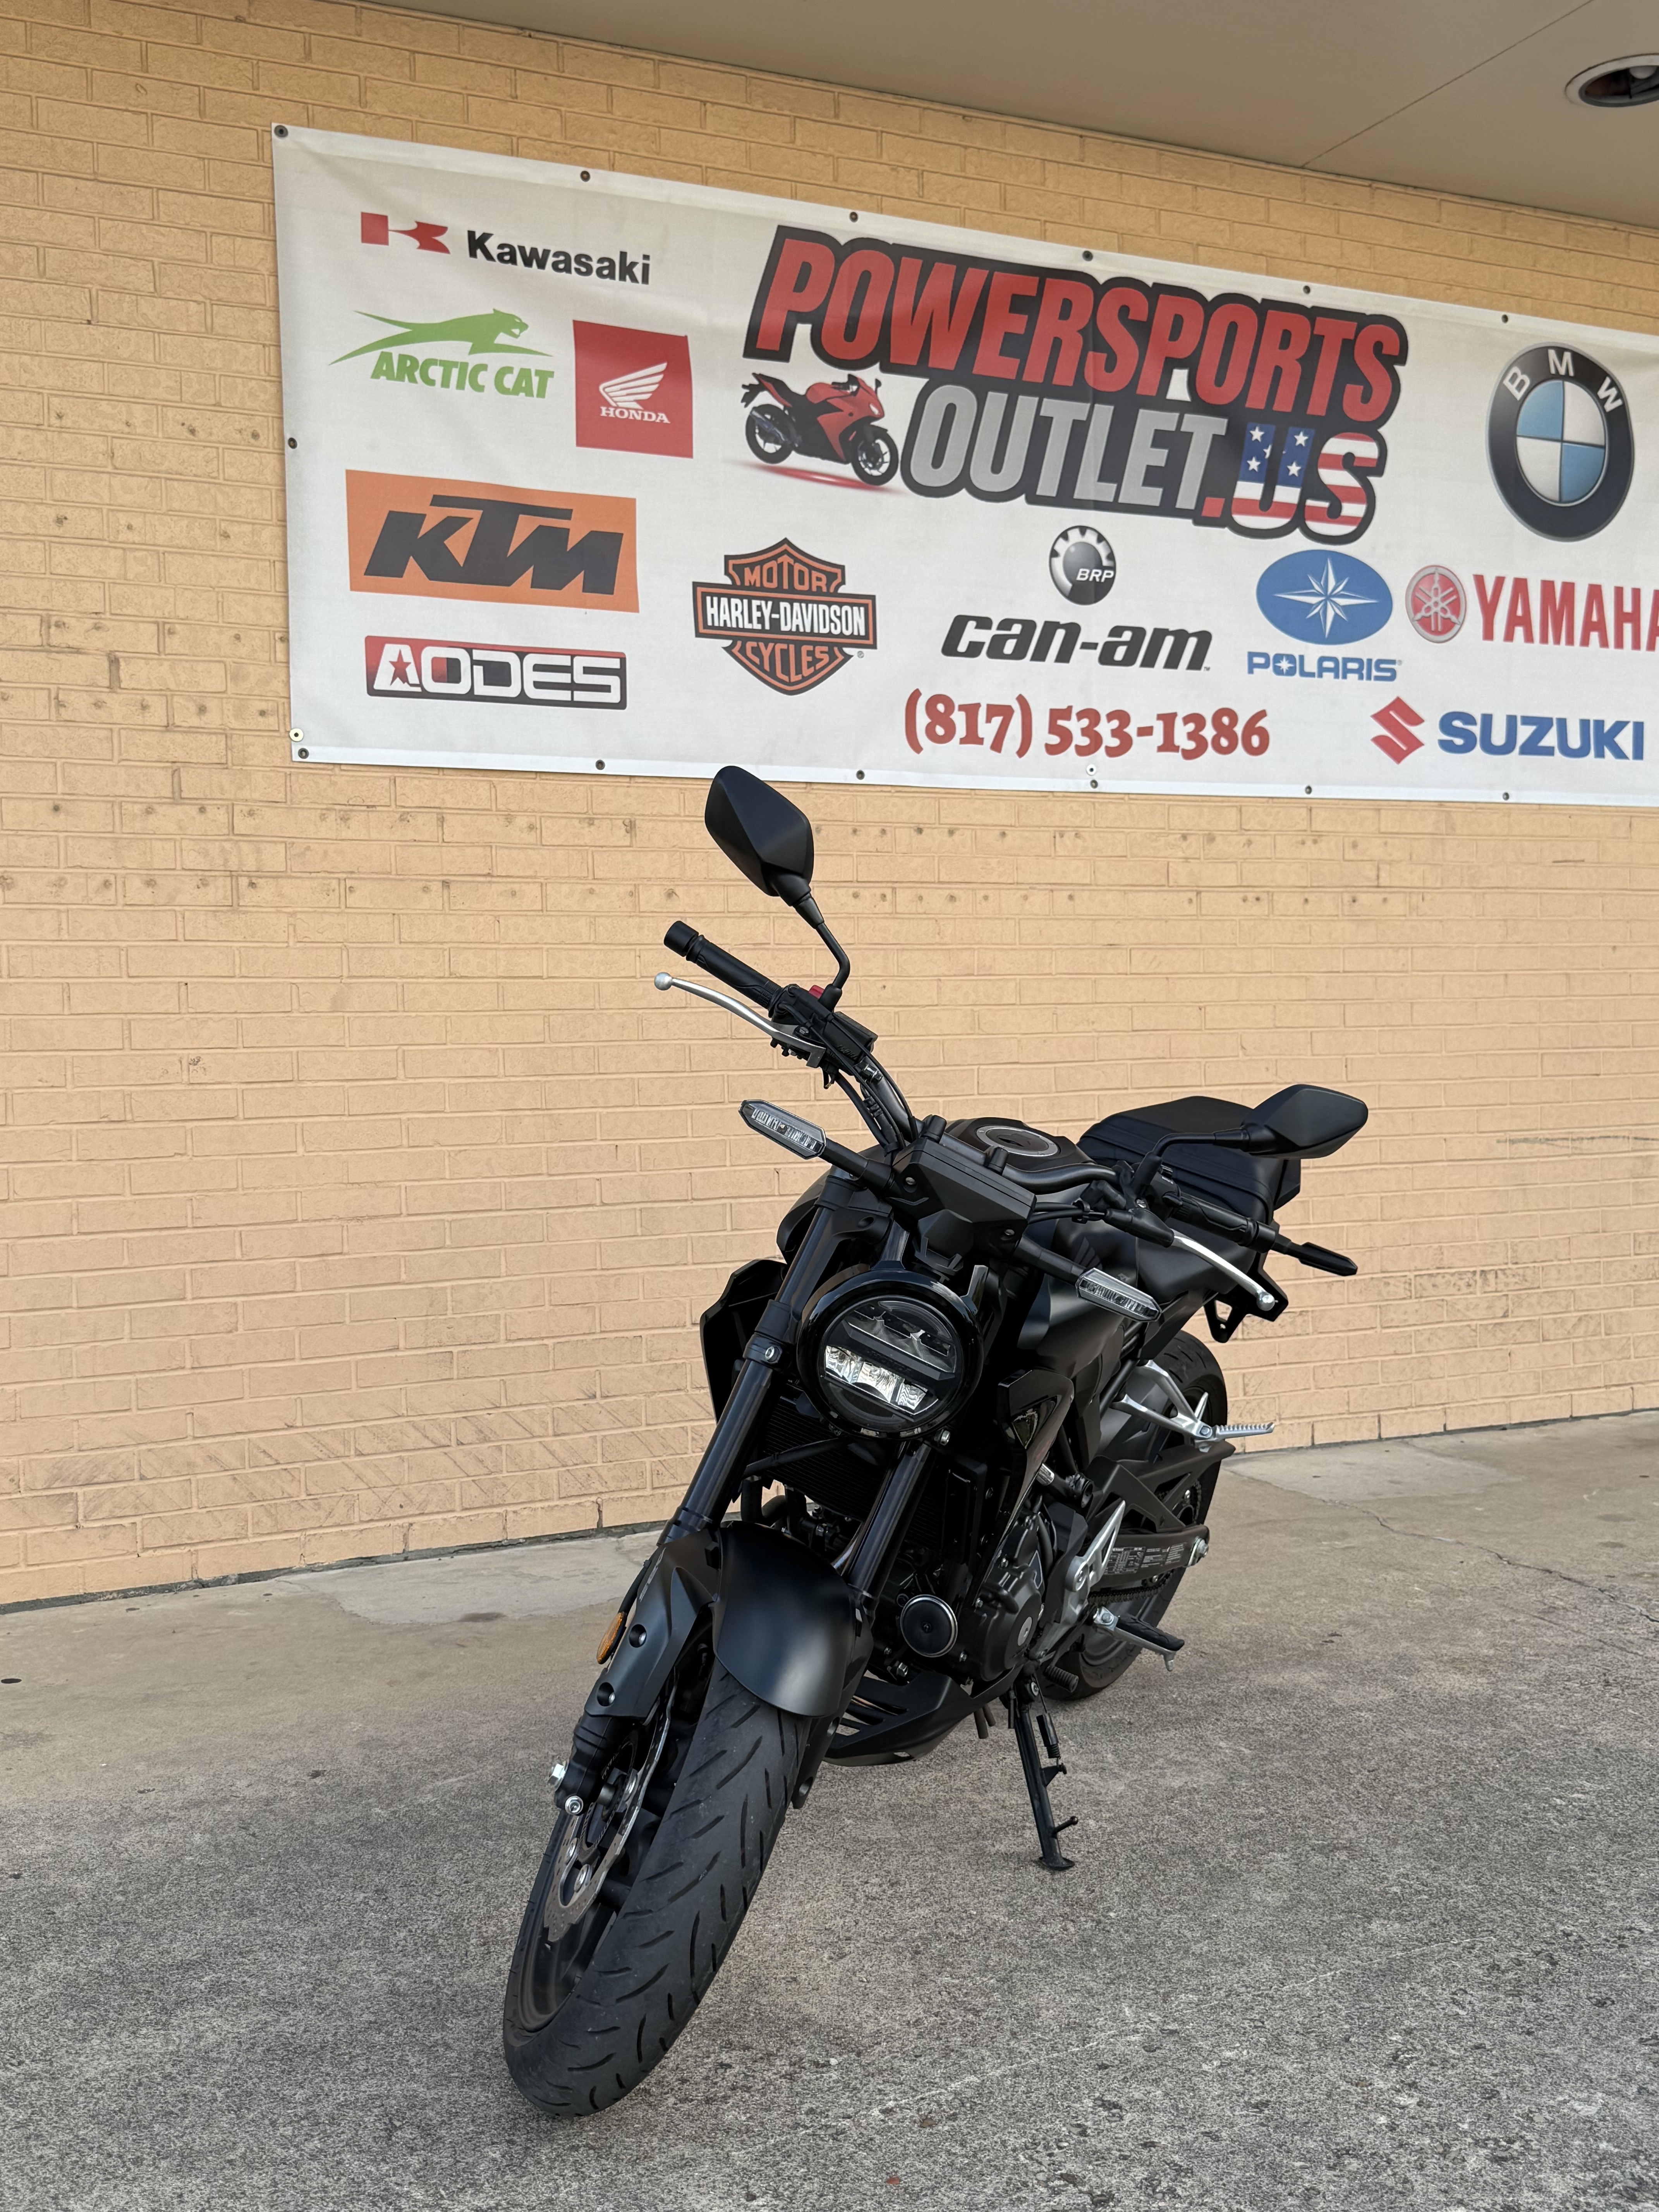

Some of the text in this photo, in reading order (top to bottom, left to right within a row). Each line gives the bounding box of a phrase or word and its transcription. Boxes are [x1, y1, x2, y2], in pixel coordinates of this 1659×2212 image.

[467, 230, 650, 285] Kawasaki
[756, 238, 1400, 422] POWERSPORTS
[371, 350, 554, 398] ARCTIC CAT
[1503, 349, 1623, 413] BMW
[600, 406, 671, 424] HONDA
[910, 385, 1379, 536] OUTLET.US
[364, 494, 624, 595] KTM
[744, 555, 828, 593] MOTOR
[1075, 568, 1114, 583] BRP
[706, 596, 866, 637] HARLEY-DAVIDSON
[941, 614, 1212, 671] can-am
[373, 643, 621, 704] AODES
[745, 641, 830, 683] CYCLES
[1247, 651, 1397, 682] POLARIS
[905, 688, 1270, 760] (817) 533-1386
[1437, 711, 1644, 761] SUZUKI
